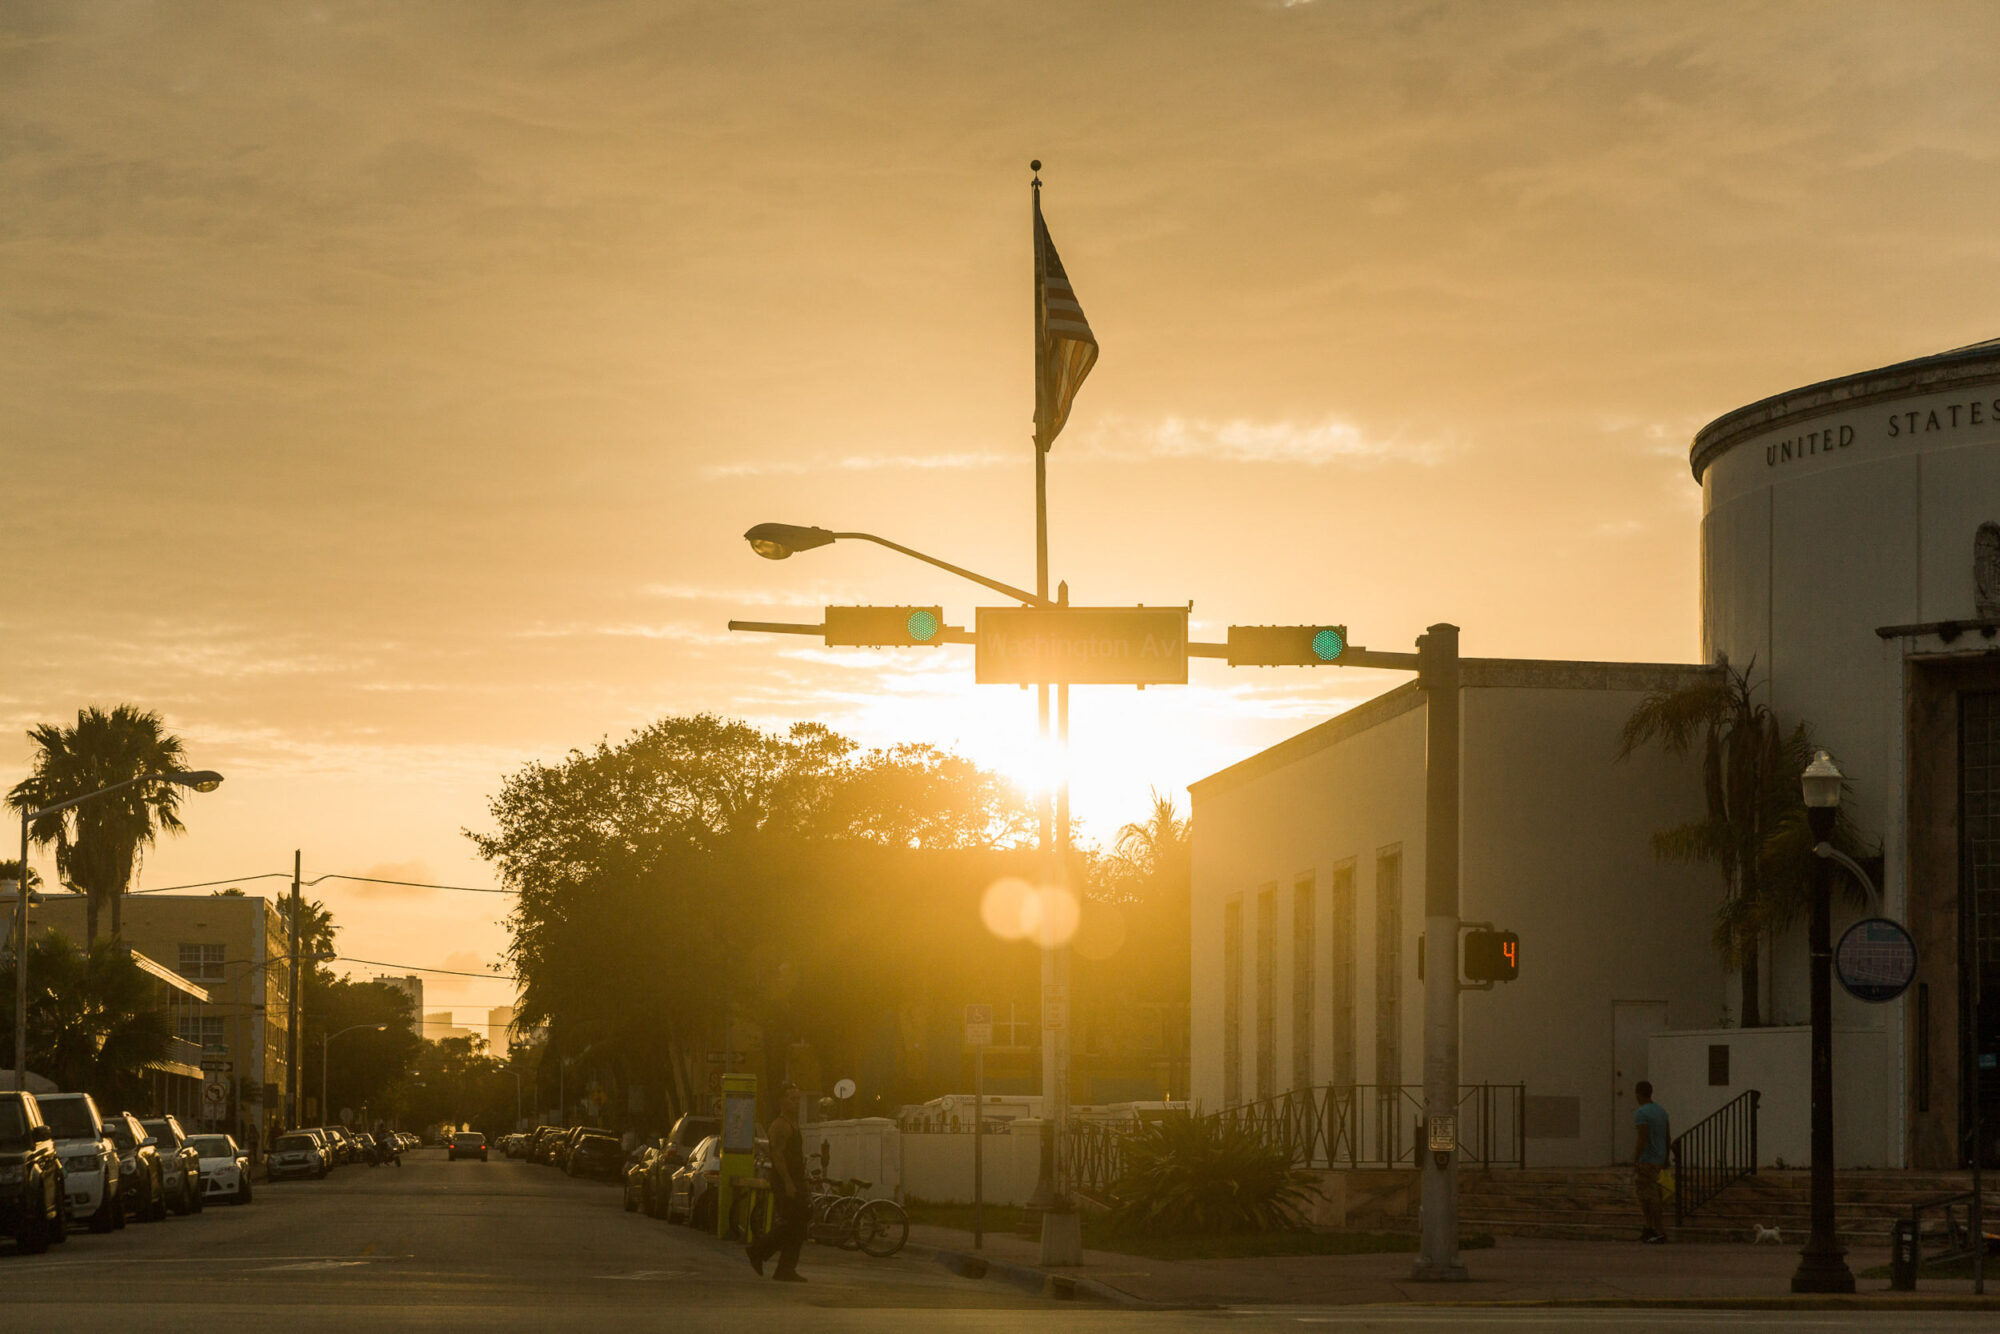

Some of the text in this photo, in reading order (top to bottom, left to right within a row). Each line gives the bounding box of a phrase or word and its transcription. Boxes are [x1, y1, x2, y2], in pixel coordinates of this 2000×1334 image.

[1766, 425, 1855, 466] UNITED
[987, 632, 1177, 664] Washington Av
[1503, 942, 1515, 968] 4
